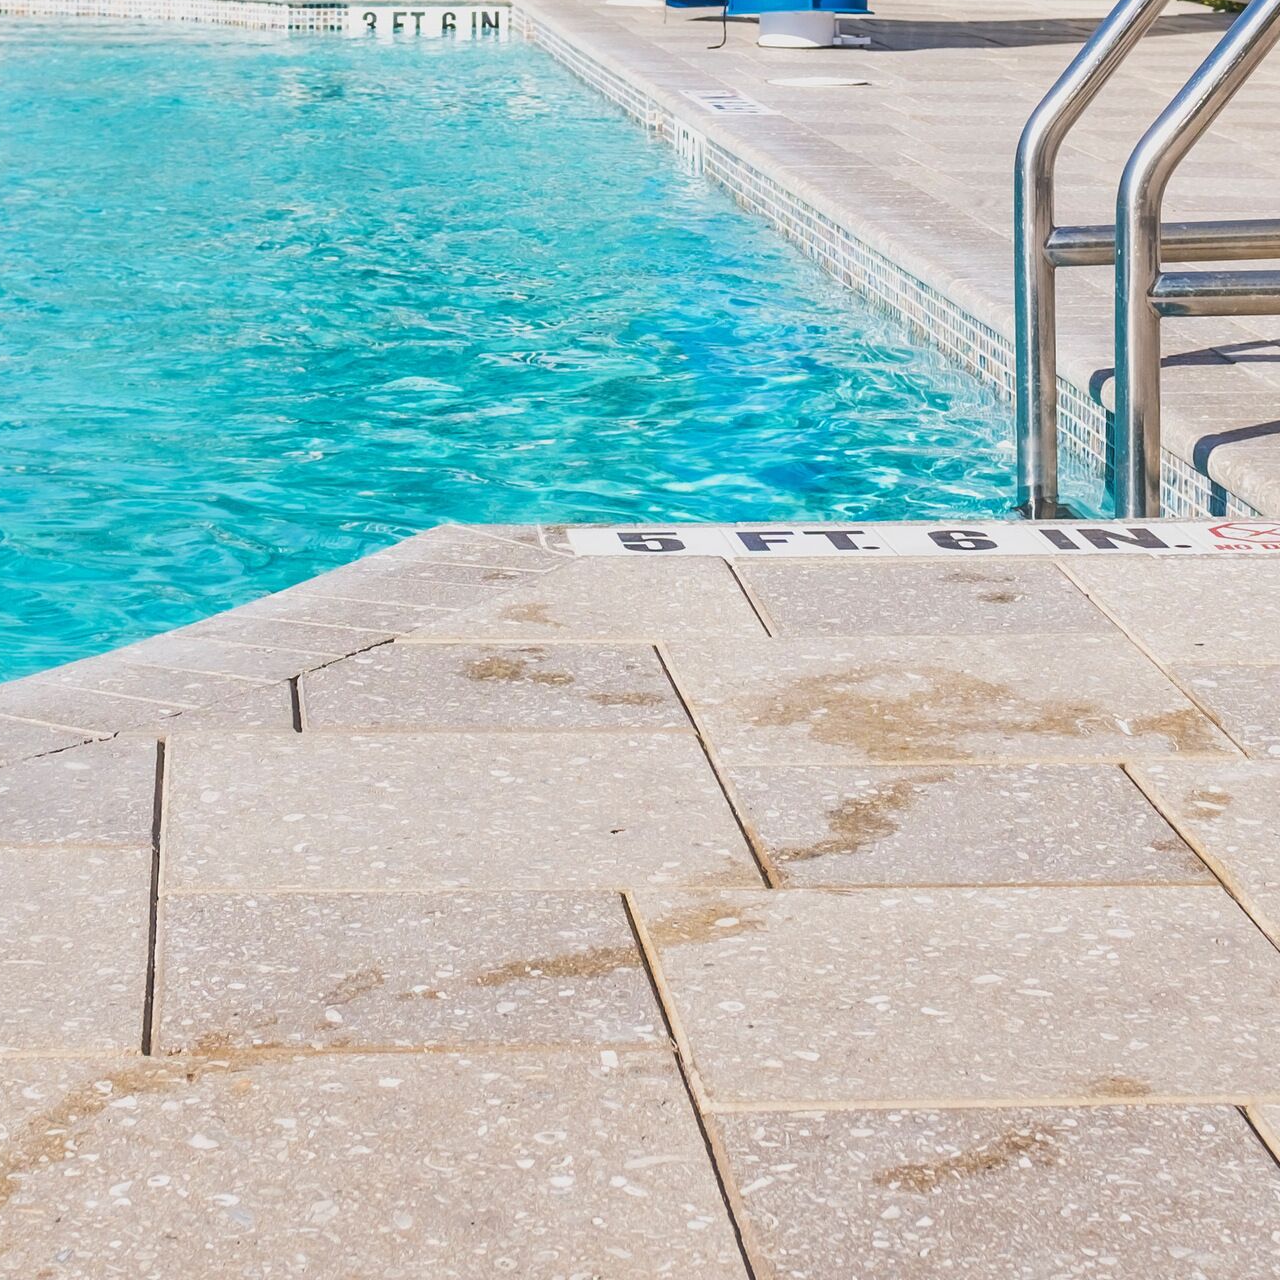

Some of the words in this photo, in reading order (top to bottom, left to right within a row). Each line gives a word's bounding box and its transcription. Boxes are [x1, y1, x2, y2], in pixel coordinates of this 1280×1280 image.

[472, 11, 500, 29] IN
[617, 531, 686, 552] 5
[735, 530, 881, 551] FT.
[927, 530, 998, 551] 6
[1039, 528, 1192, 550] IN.
[1213, 543, 1254, 552] NO
